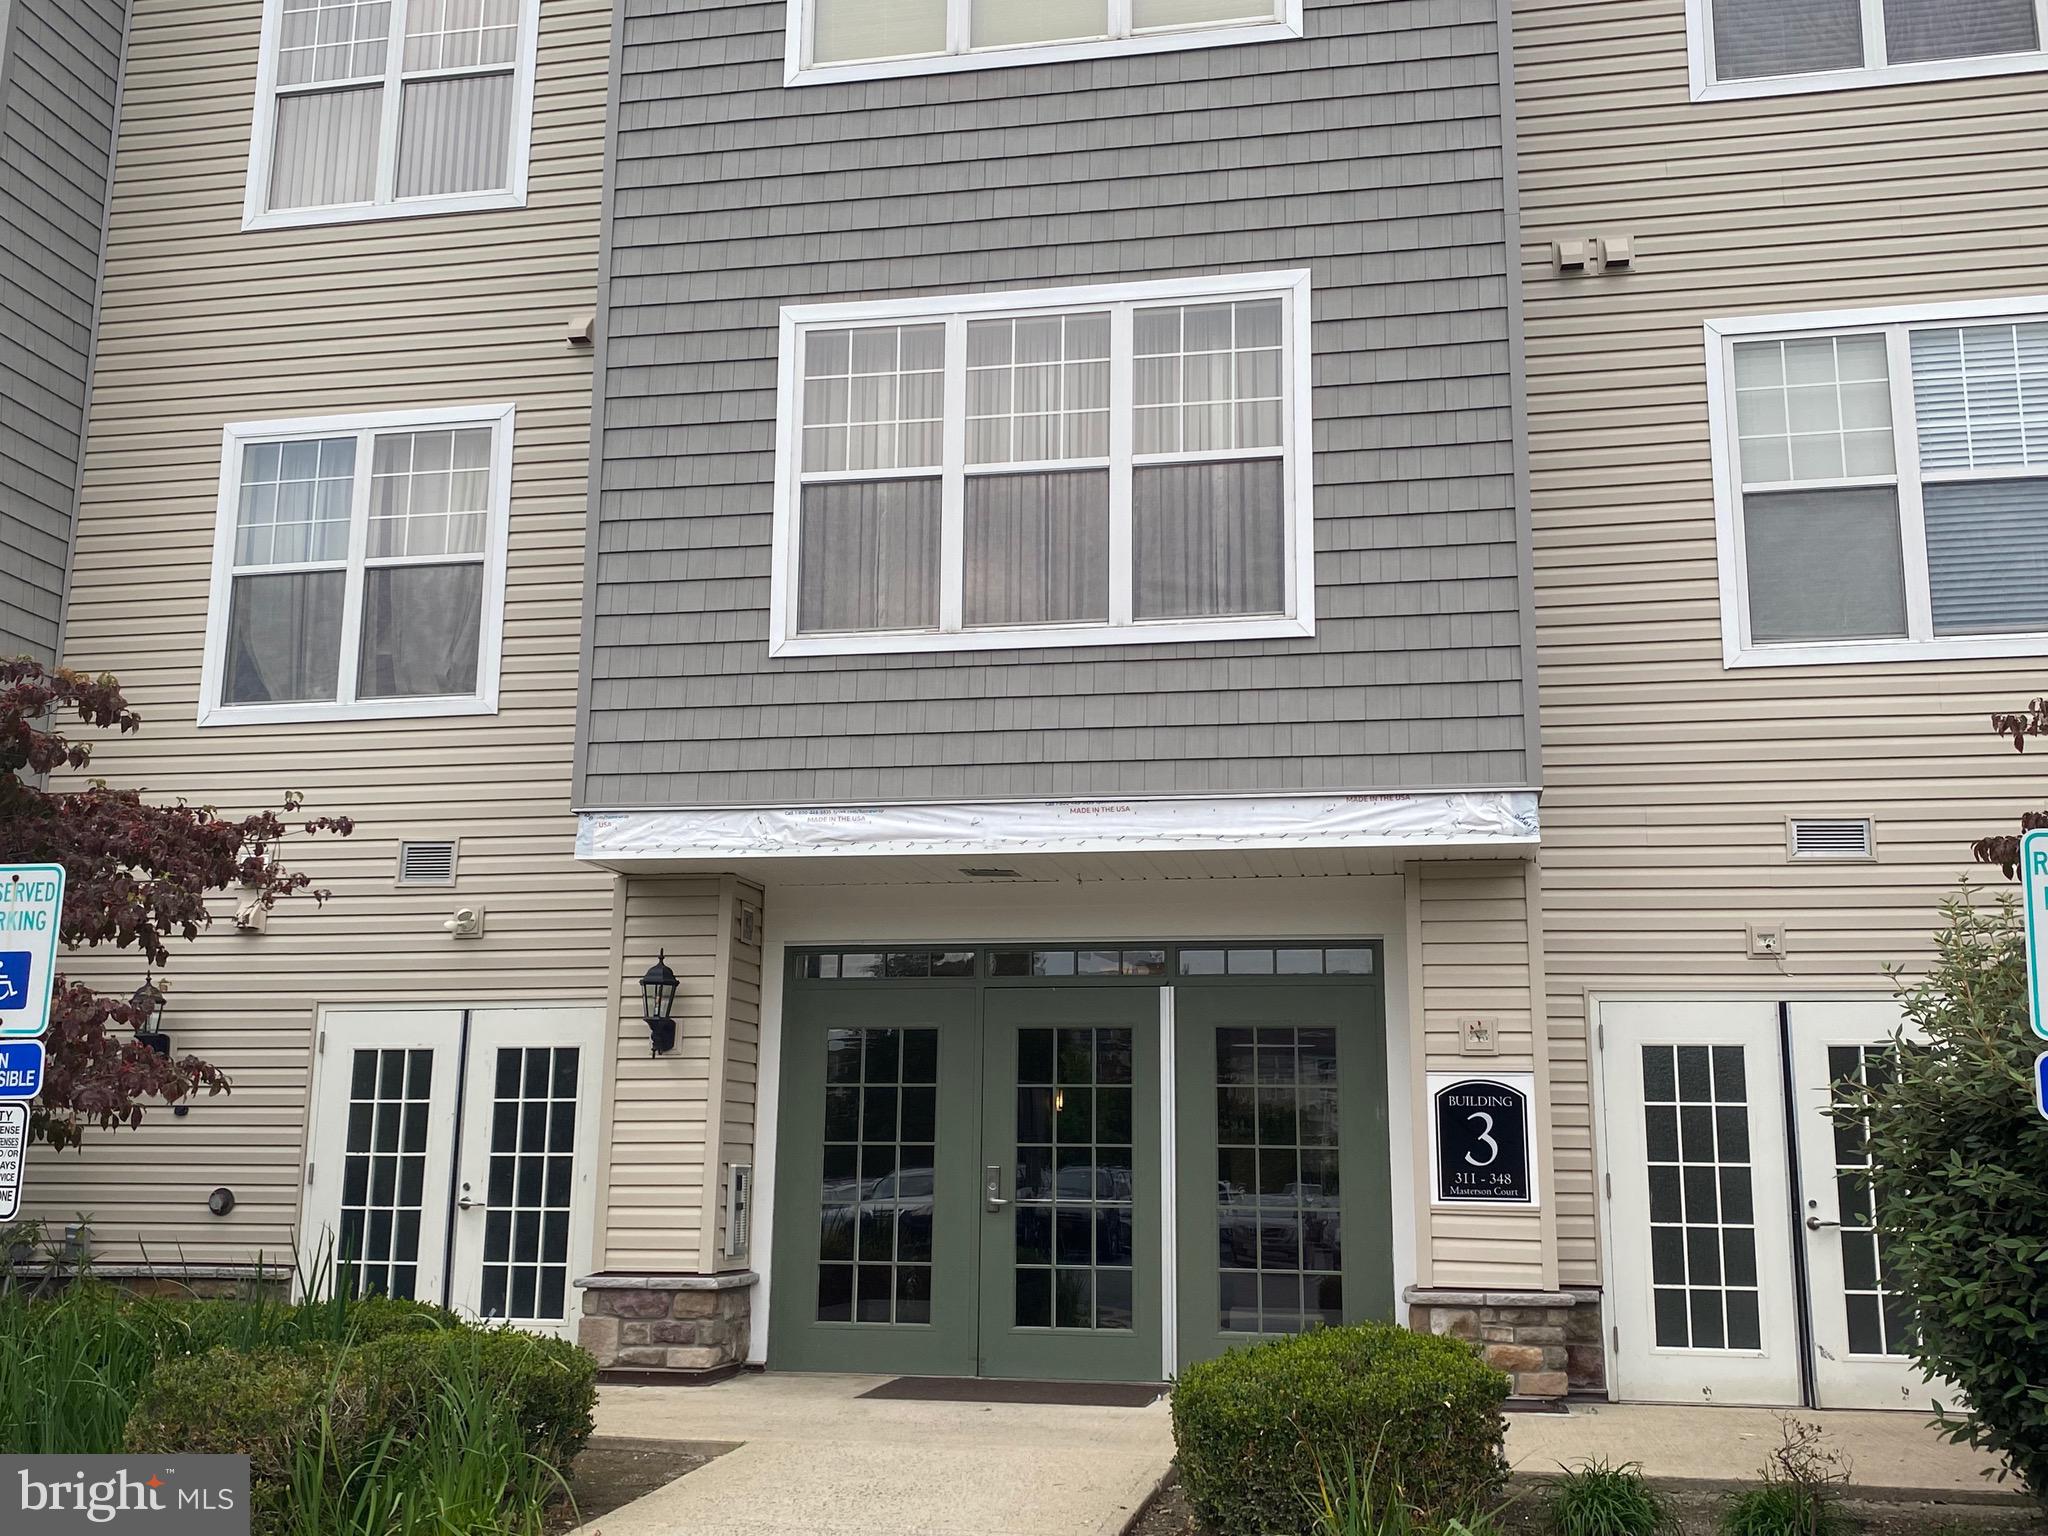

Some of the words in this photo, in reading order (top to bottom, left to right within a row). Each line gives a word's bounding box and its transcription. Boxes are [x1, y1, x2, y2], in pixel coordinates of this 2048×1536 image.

[1448, 1095, 1513, 1107] BUILDING
[1465, 1111, 1498, 1167] 3
[1454, 1172, 1476, 1184] 311
[1489, 1173, 1512, 1185] 348
[1449, 1186, 1492, 1196] Masterson
[1494, 1186, 1519, 1196] Court
